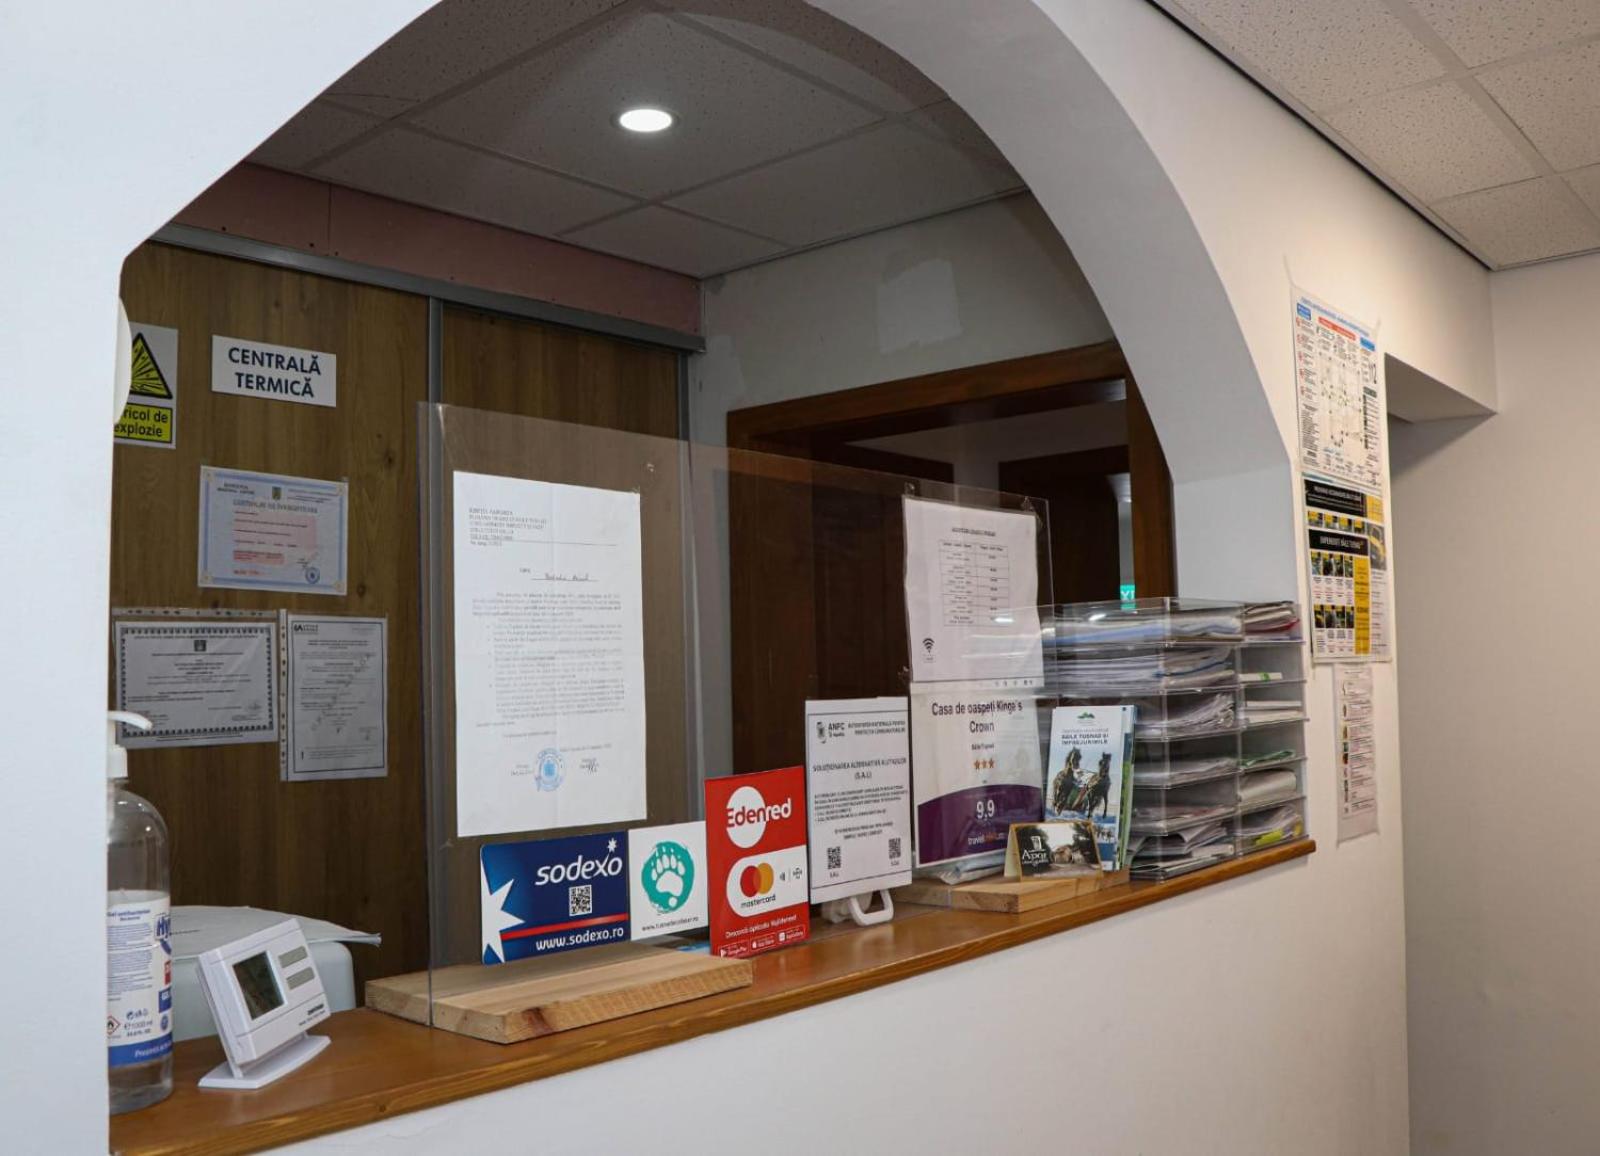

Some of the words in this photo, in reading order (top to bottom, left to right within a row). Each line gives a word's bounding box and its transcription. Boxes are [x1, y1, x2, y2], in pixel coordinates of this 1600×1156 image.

[228, 347, 321, 376] CENTRALĂ
[234, 371, 314, 398] TERMICĂ
[123, 406, 150, 421] ricol
[153, 410, 168, 424] de
[114, 422, 163, 437] explozie
[931, 703, 953, 716] Casa
[955, 702, 966, 714] de
[828, 722, 845, 731] ANPC
[969, 720, 995, 733] Crown
[726, 798, 792, 828] Edenred
[534, 853, 623, 886] sodexo
[740, 893, 776, 909] mastercard
[535, 926, 624, 951] www.sodexo.ro
